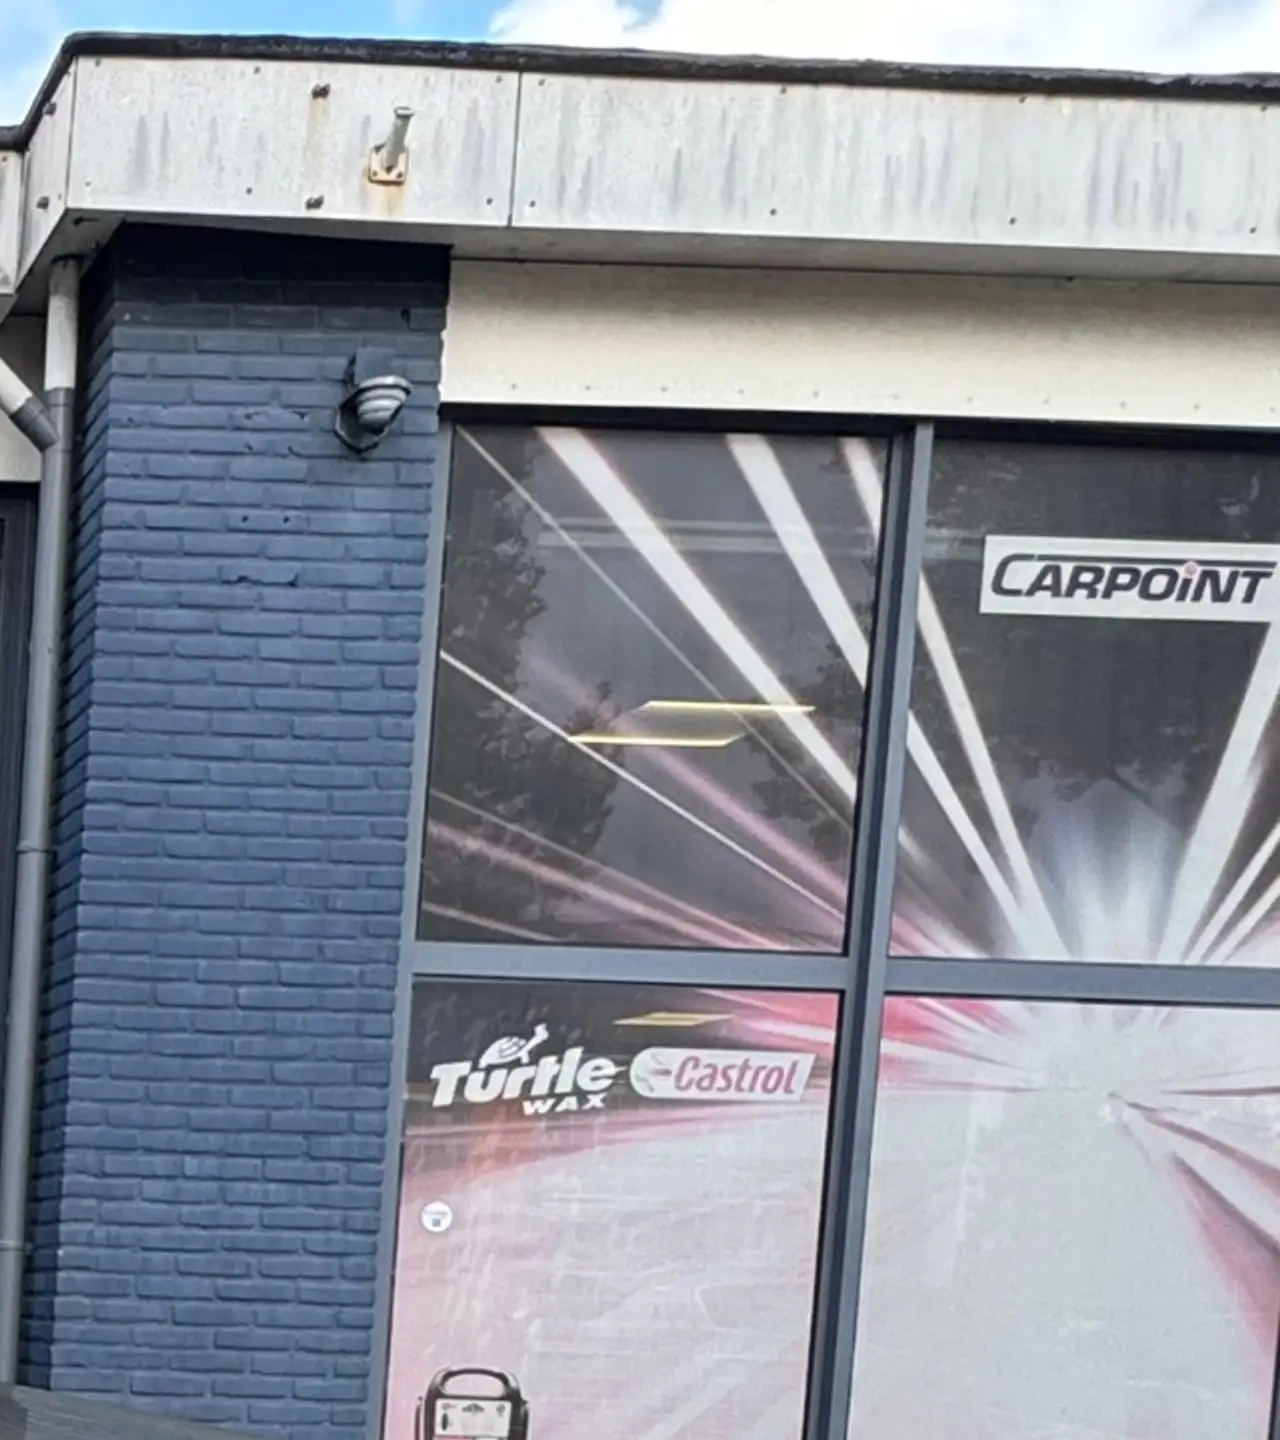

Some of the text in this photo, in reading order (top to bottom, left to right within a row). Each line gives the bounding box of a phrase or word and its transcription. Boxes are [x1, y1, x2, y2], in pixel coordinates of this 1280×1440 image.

[430, 1046, 618, 1107] Turtle
[673, 1055, 801, 1095] Castrol
[522, 1093, 606, 1116] WAX
